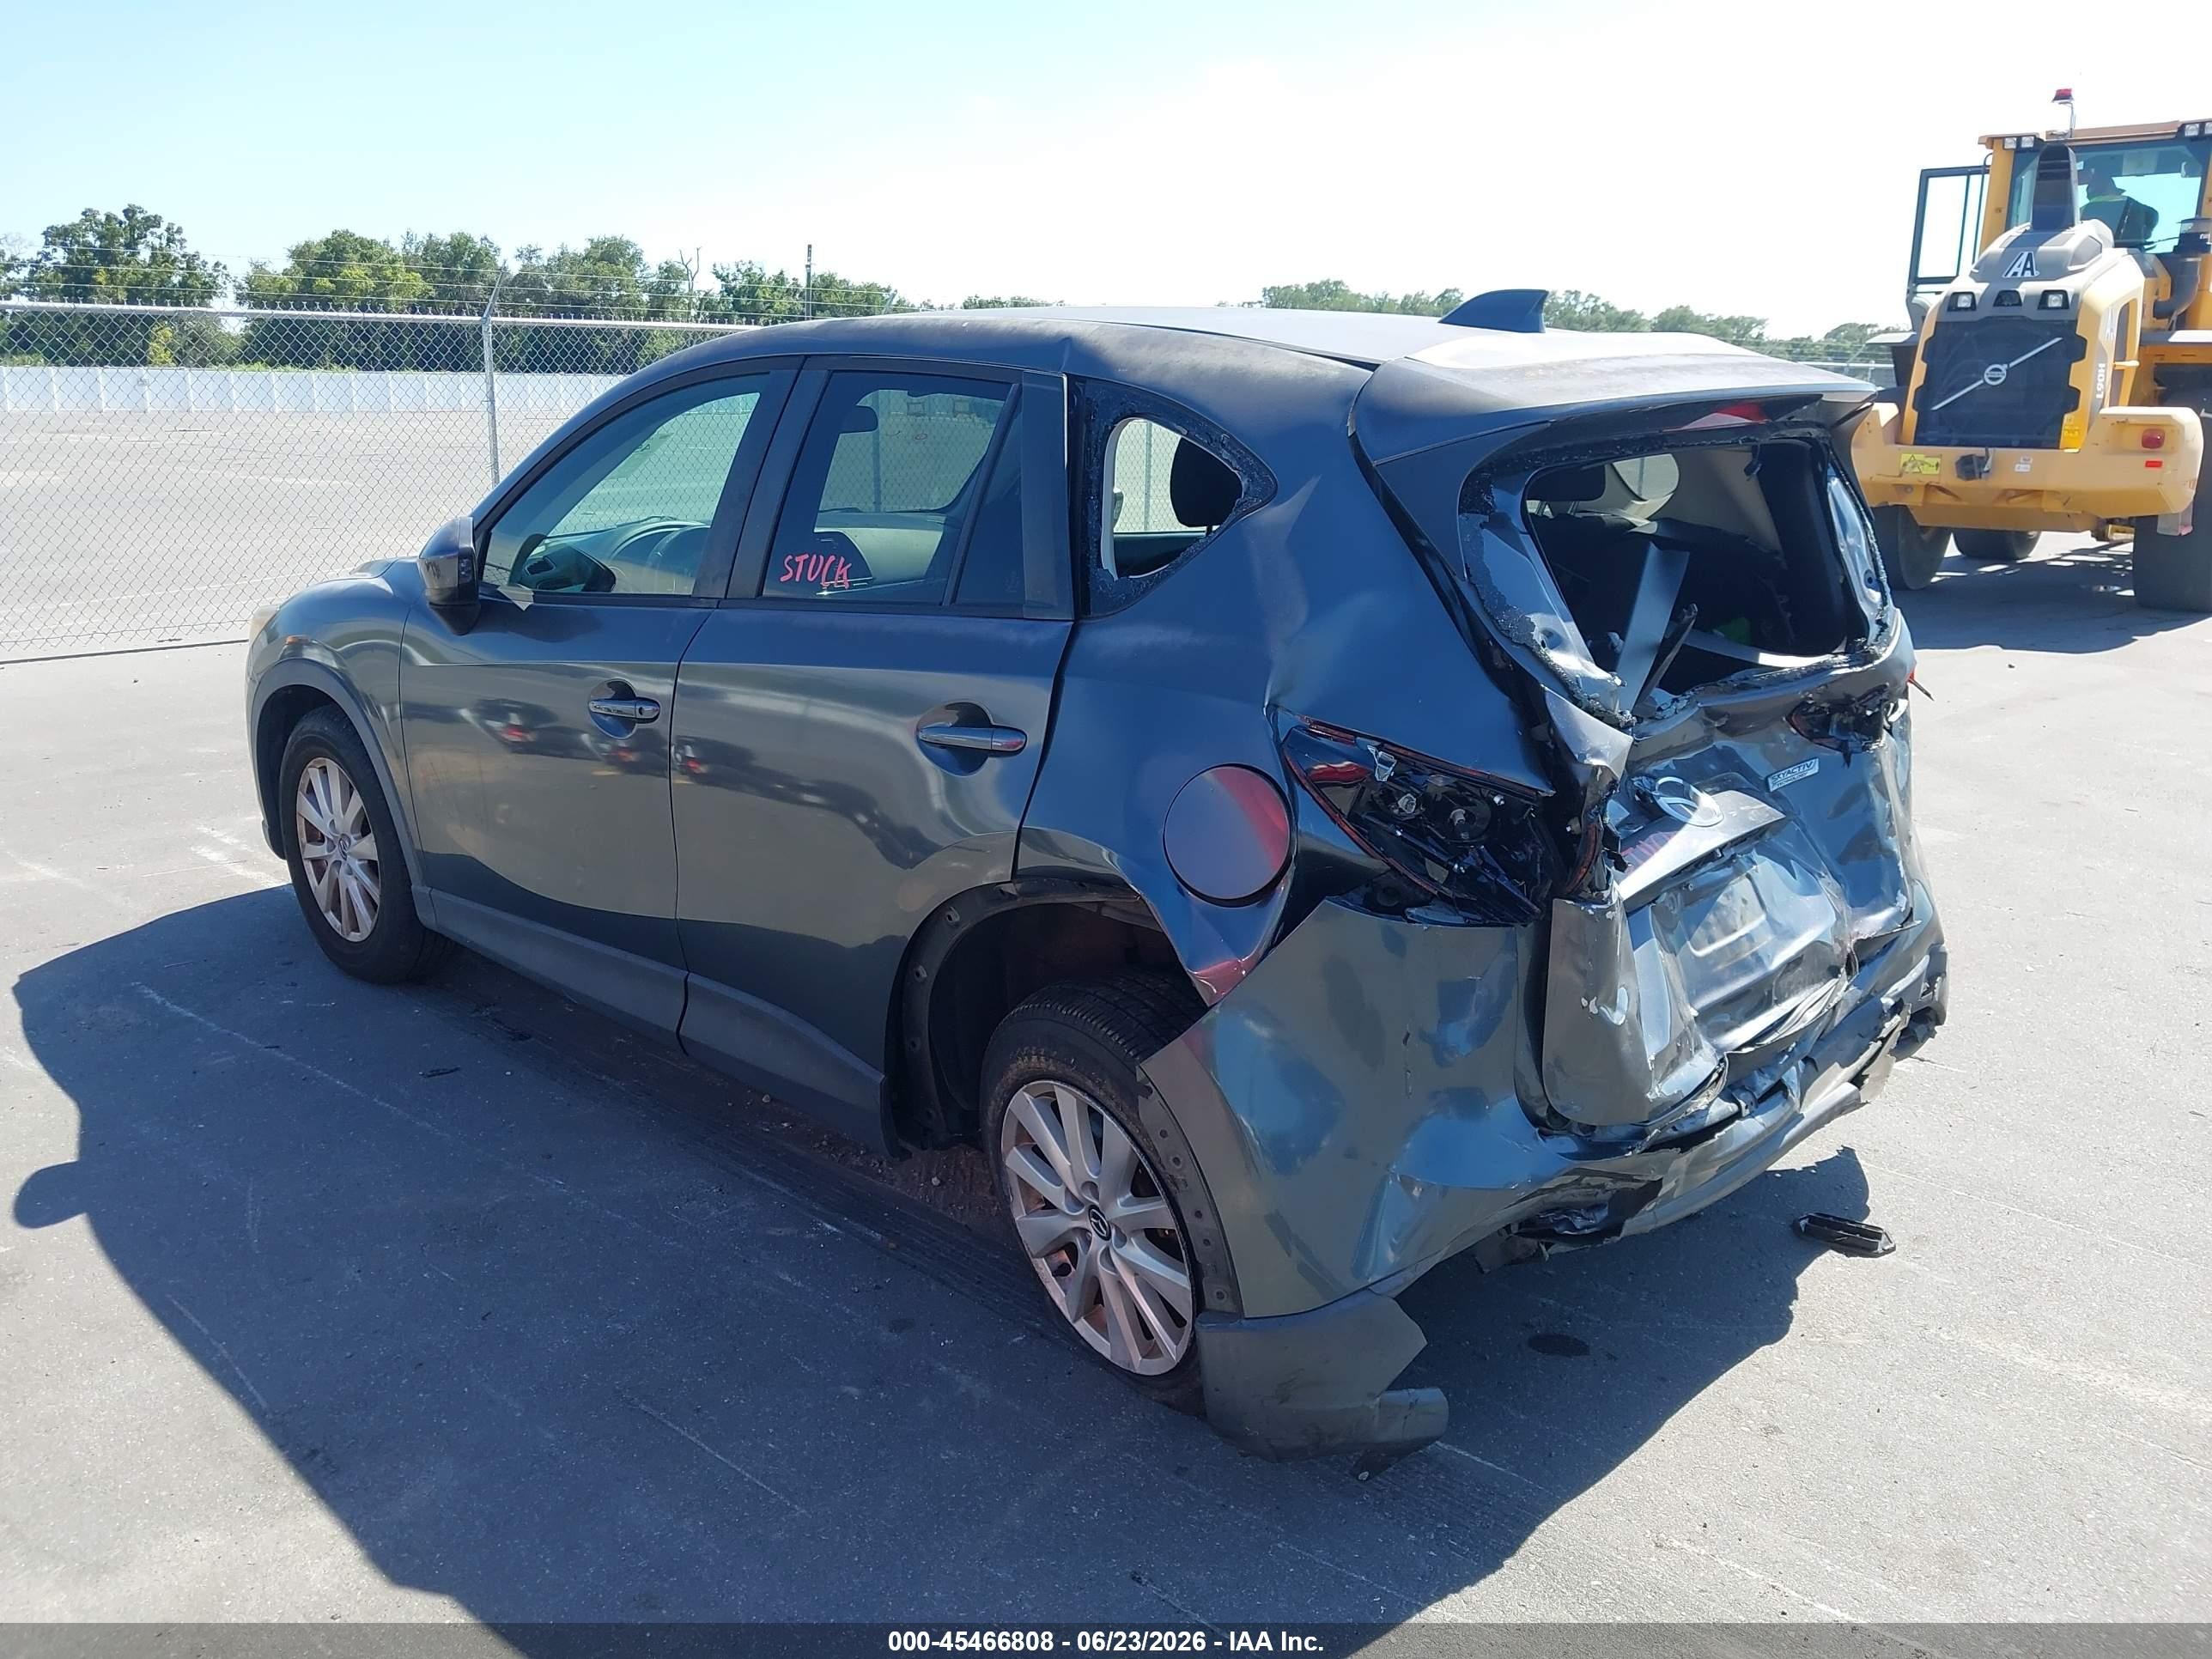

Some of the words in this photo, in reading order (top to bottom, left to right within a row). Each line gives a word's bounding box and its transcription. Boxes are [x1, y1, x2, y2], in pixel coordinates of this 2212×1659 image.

[2095, 362, 2106, 399] L90H
[780, 554, 852, 589] STUCK
[1771, 761, 1814, 782] SKYACTIV
